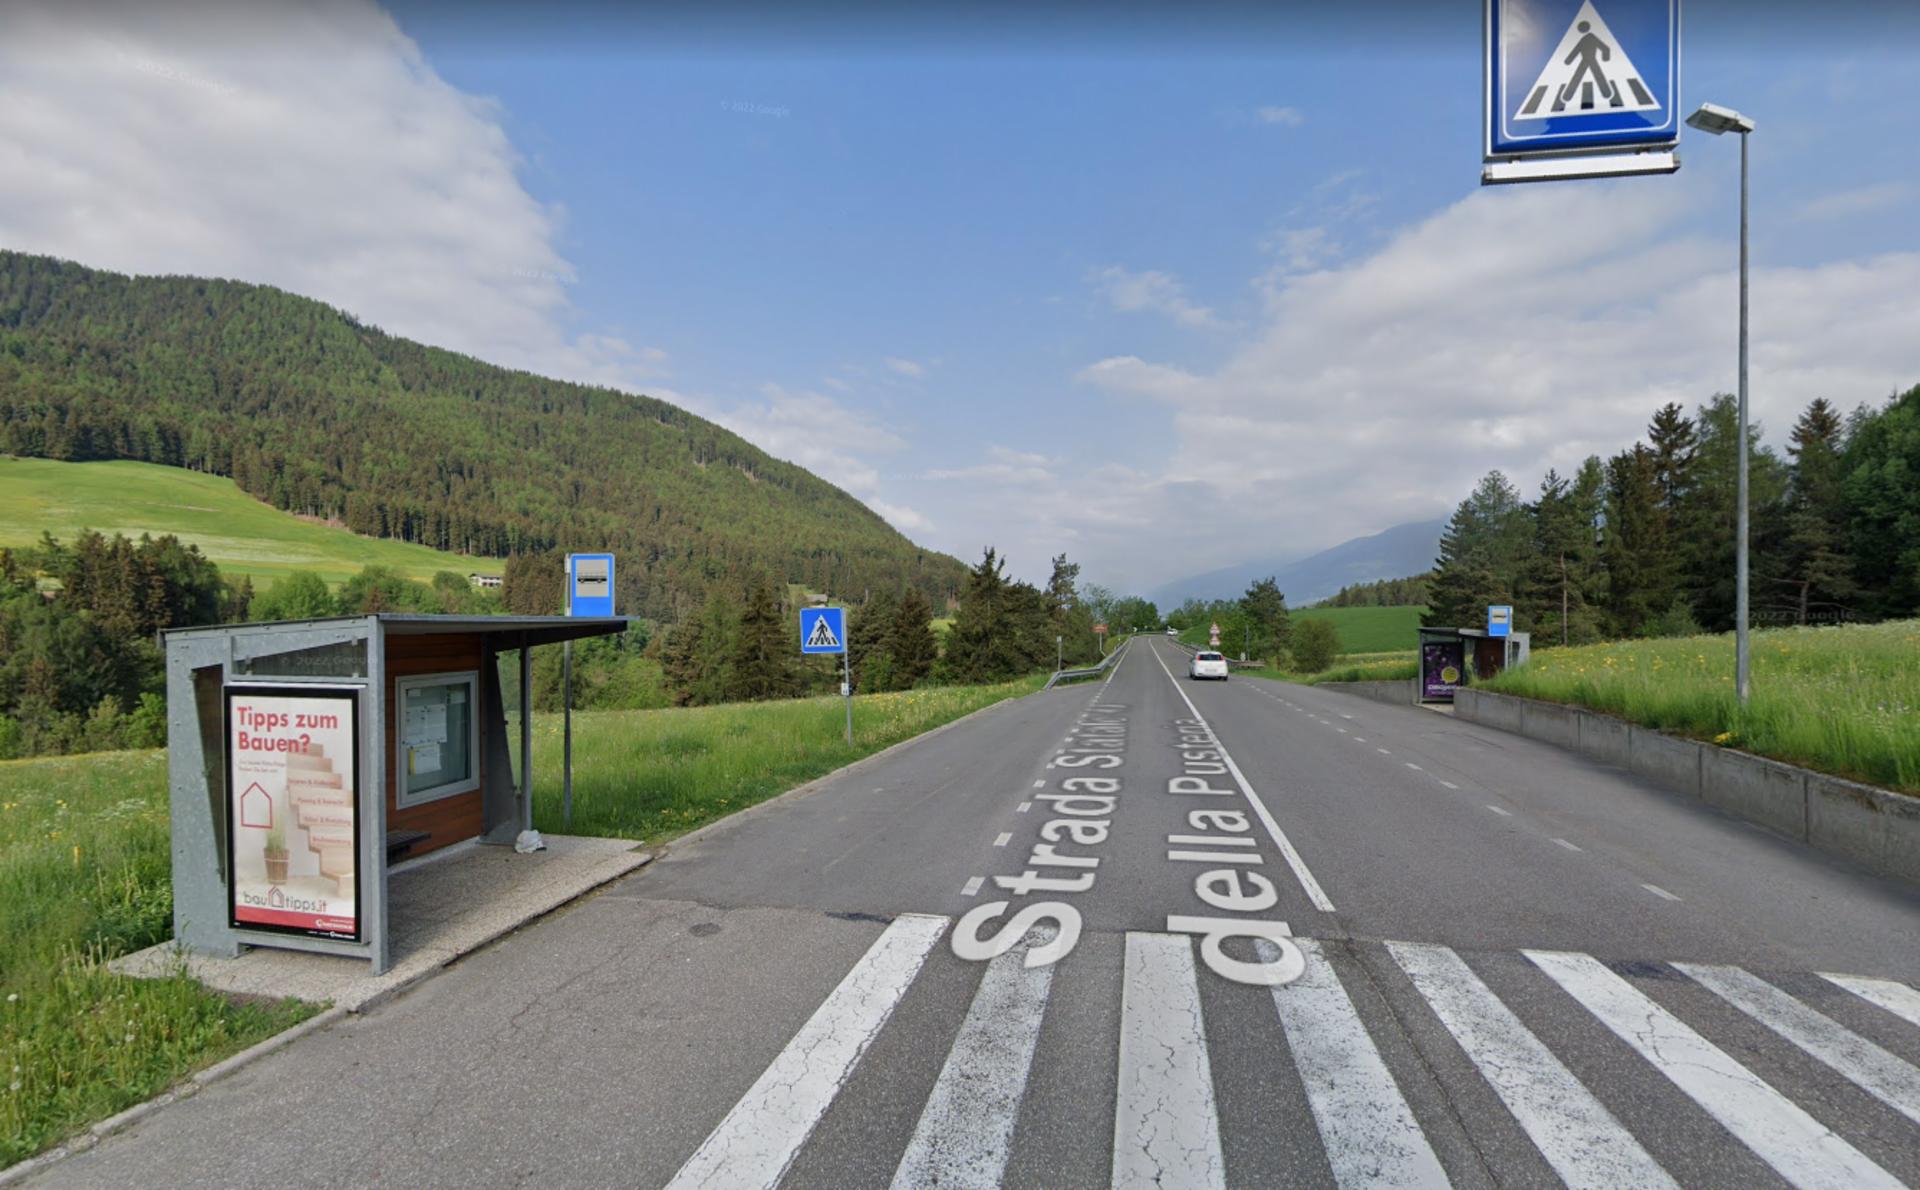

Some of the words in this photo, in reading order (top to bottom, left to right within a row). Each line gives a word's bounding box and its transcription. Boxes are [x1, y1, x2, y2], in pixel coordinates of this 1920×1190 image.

[237, 706, 289, 733] Tipps
[295, 713, 339, 729] zum
[238, 731, 311, 753] Bauen?
